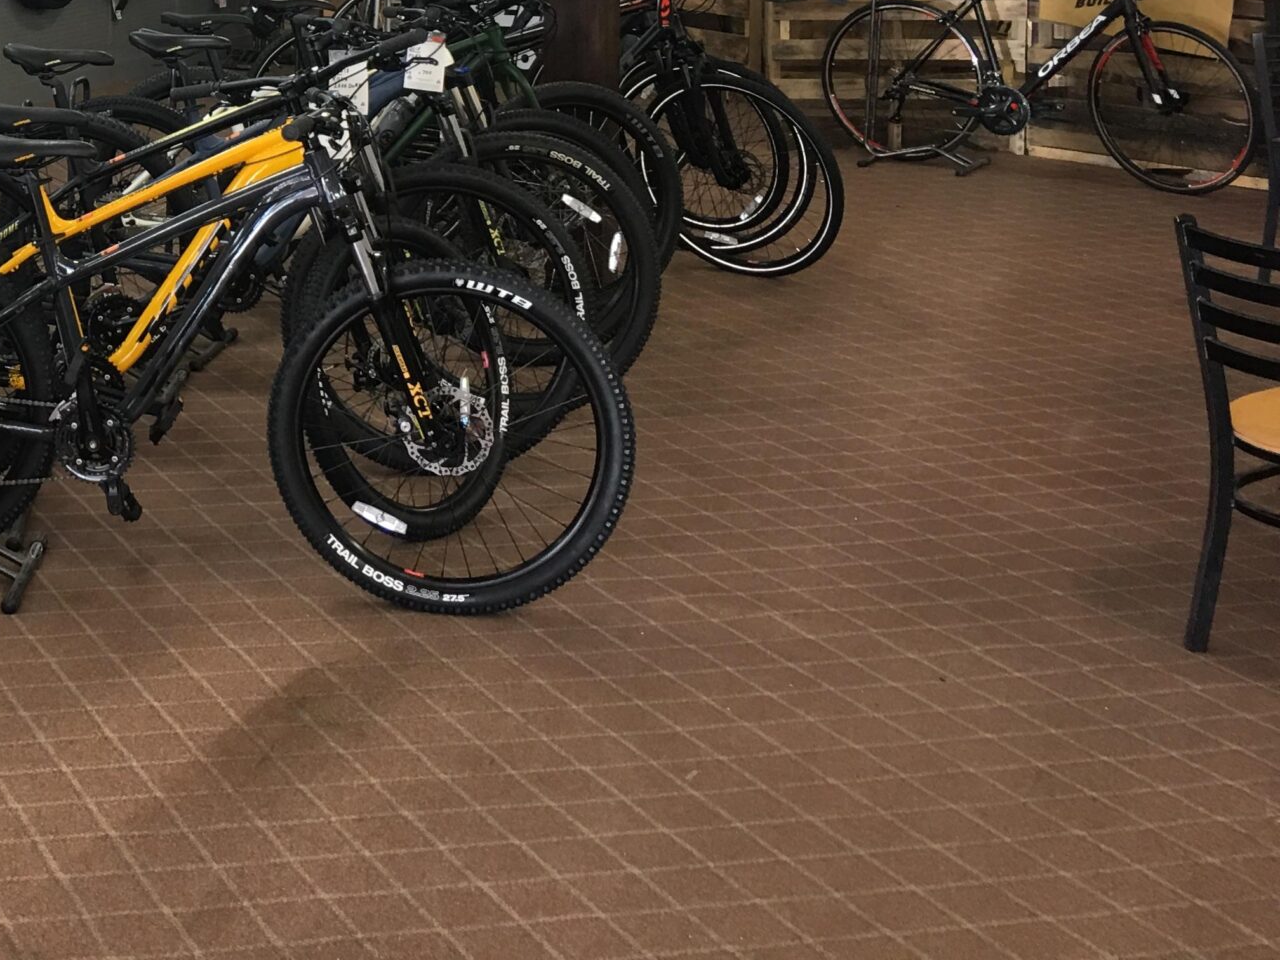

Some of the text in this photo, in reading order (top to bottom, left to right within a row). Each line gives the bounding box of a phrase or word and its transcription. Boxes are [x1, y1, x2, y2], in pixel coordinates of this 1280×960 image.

[1038, 15, 1107, 78] ORBEA
[550, 151, 612, 191] TRAIL BOSS
[488, 227, 505, 256] XCT
[466, 279, 533, 310] WTB
[561, 255, 585, 321] RAIL BOSS
[497, 357, 510, 395] BOSS
[407, 382, 433, 419] XCT
[499, 398, 510, 433] TRAIL
[326, 533, 361, 570] TRAIL
[362, 563, 404, 592] BOSS
[405, 584, 440, 601] 2.25
